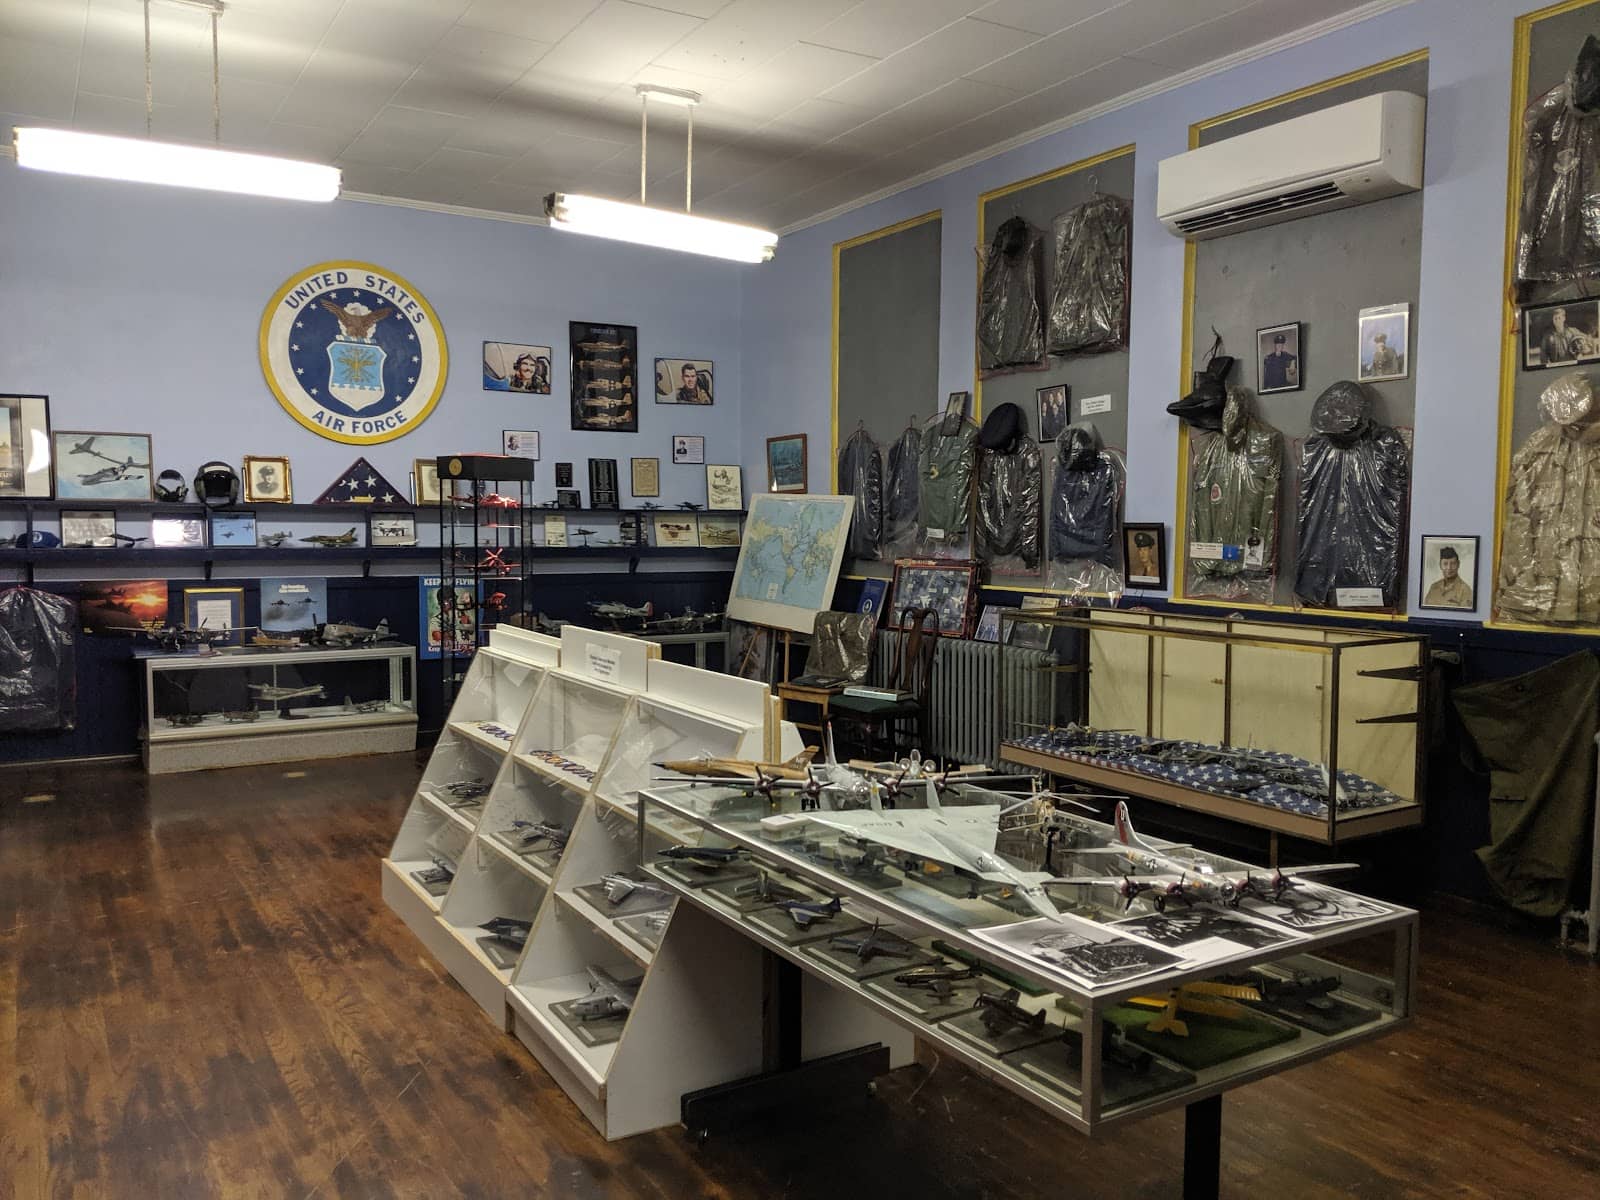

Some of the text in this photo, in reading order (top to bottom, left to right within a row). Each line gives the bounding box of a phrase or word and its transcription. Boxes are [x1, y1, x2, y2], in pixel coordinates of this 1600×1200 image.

[285, 271, 424, 324] UNITED STATES
[312, 410, 407, 434] AIR FORCE
[424, 578, 441, 586] KEEP
[455, 578, 479, 586] FLYIN
